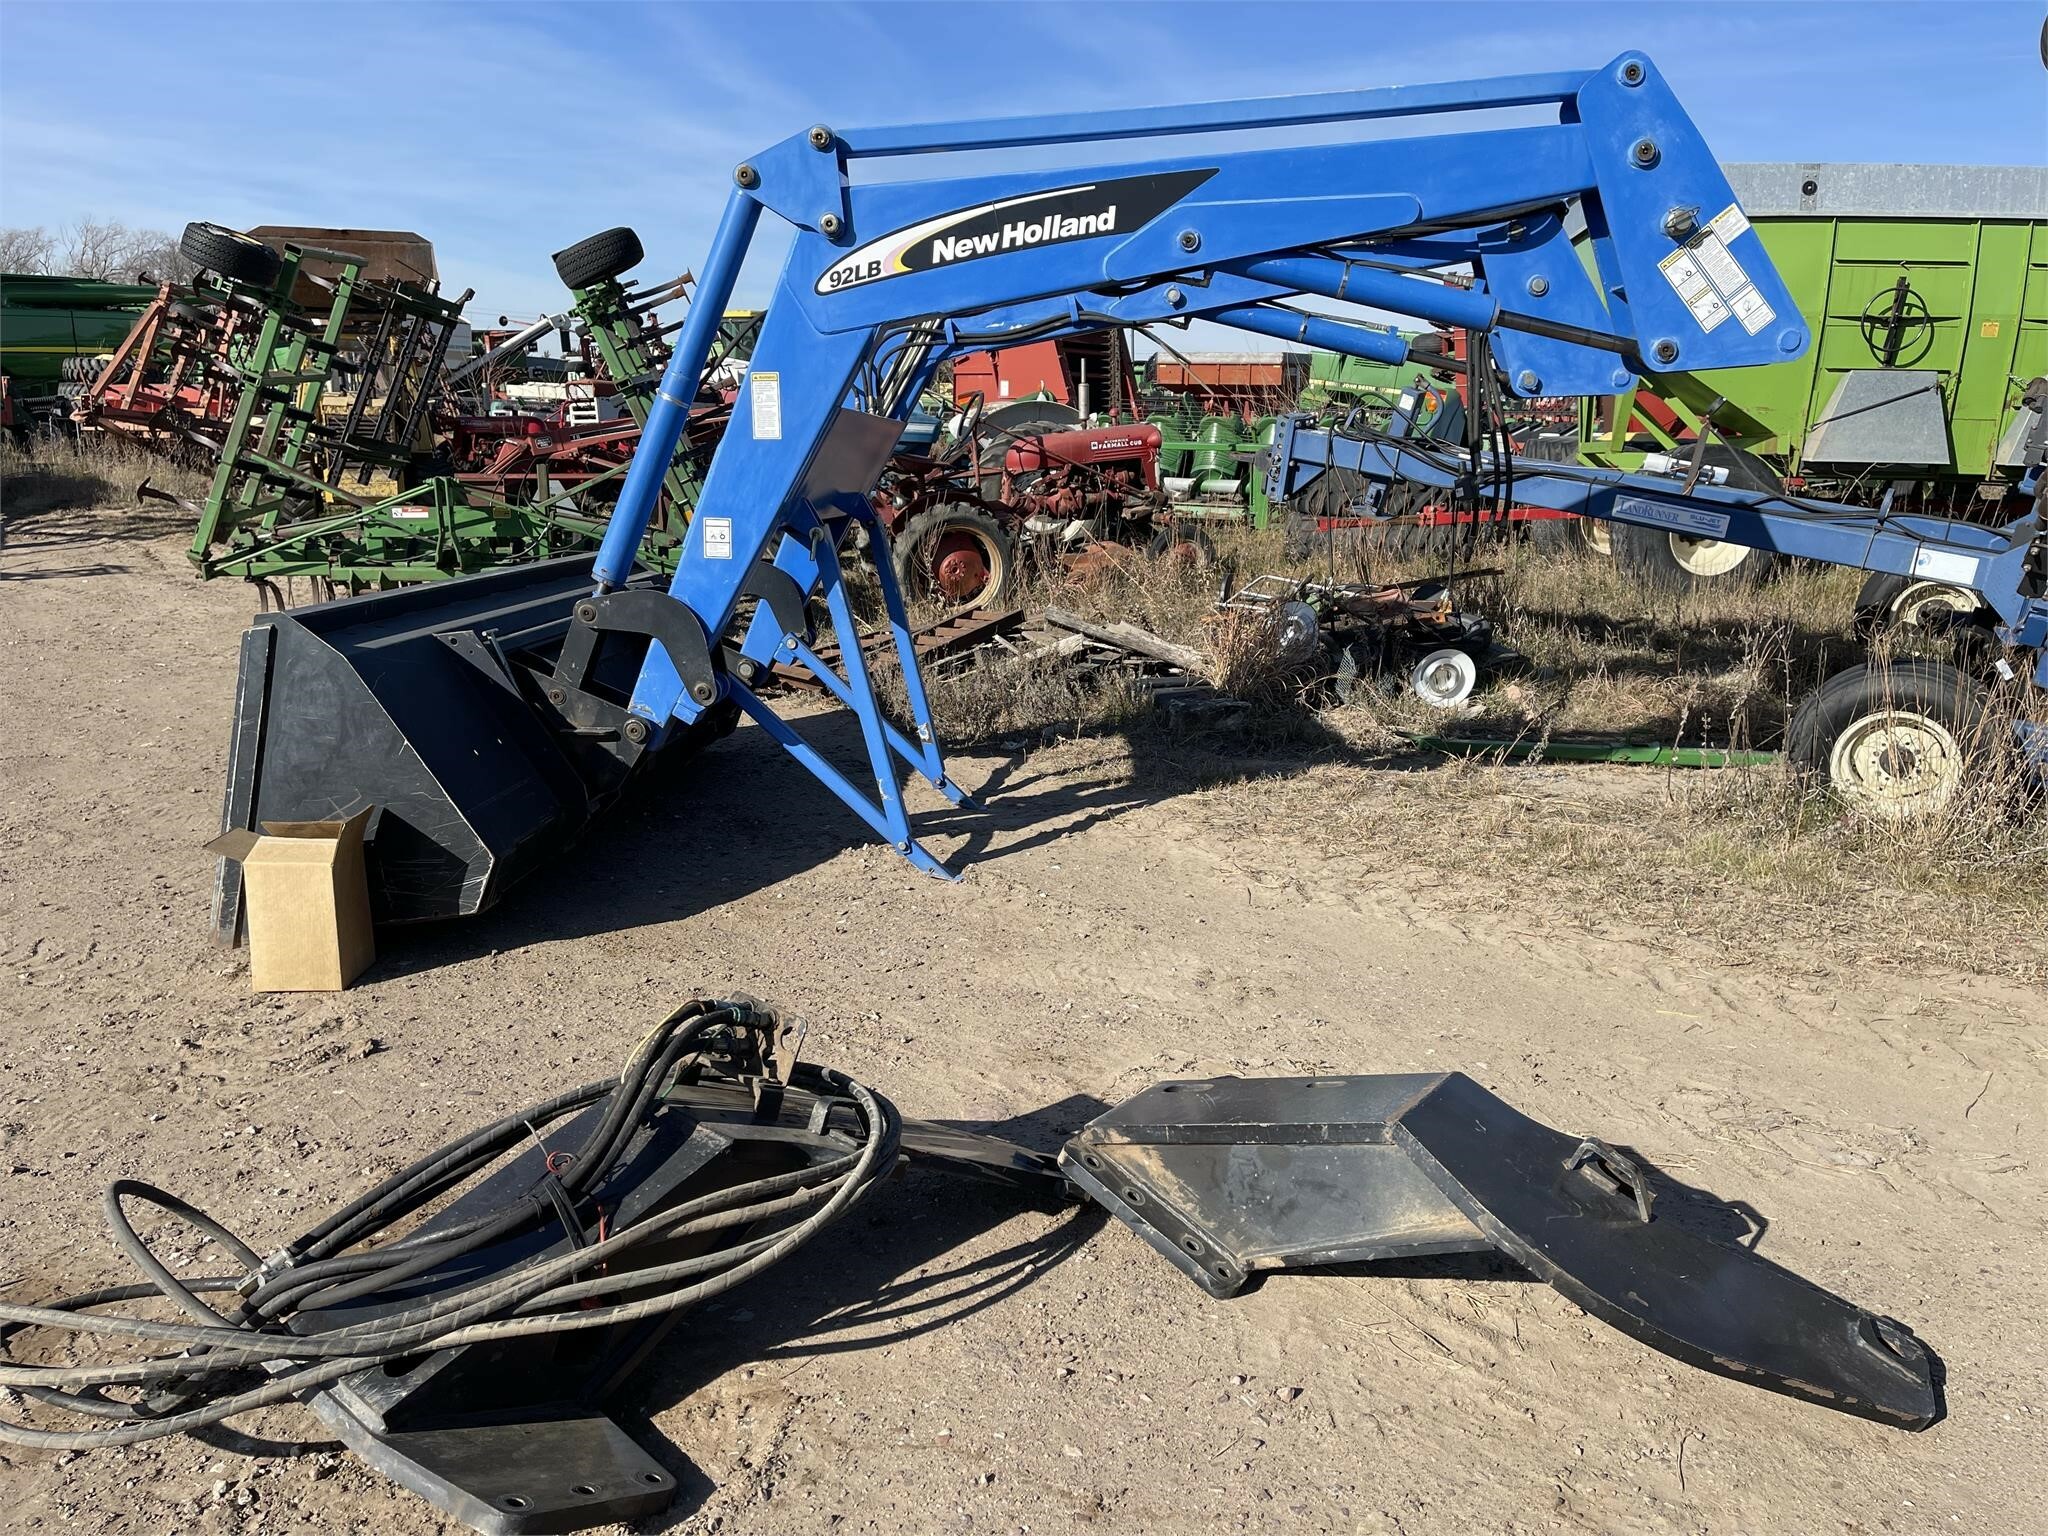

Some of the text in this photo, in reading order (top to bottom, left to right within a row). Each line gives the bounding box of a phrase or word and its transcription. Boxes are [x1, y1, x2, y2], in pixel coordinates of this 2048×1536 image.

[932, 205, 1117, 264] New Holland
[829, 259, 882, 289] 92LB
[1098, 441, 1129, 449] FARMALL
